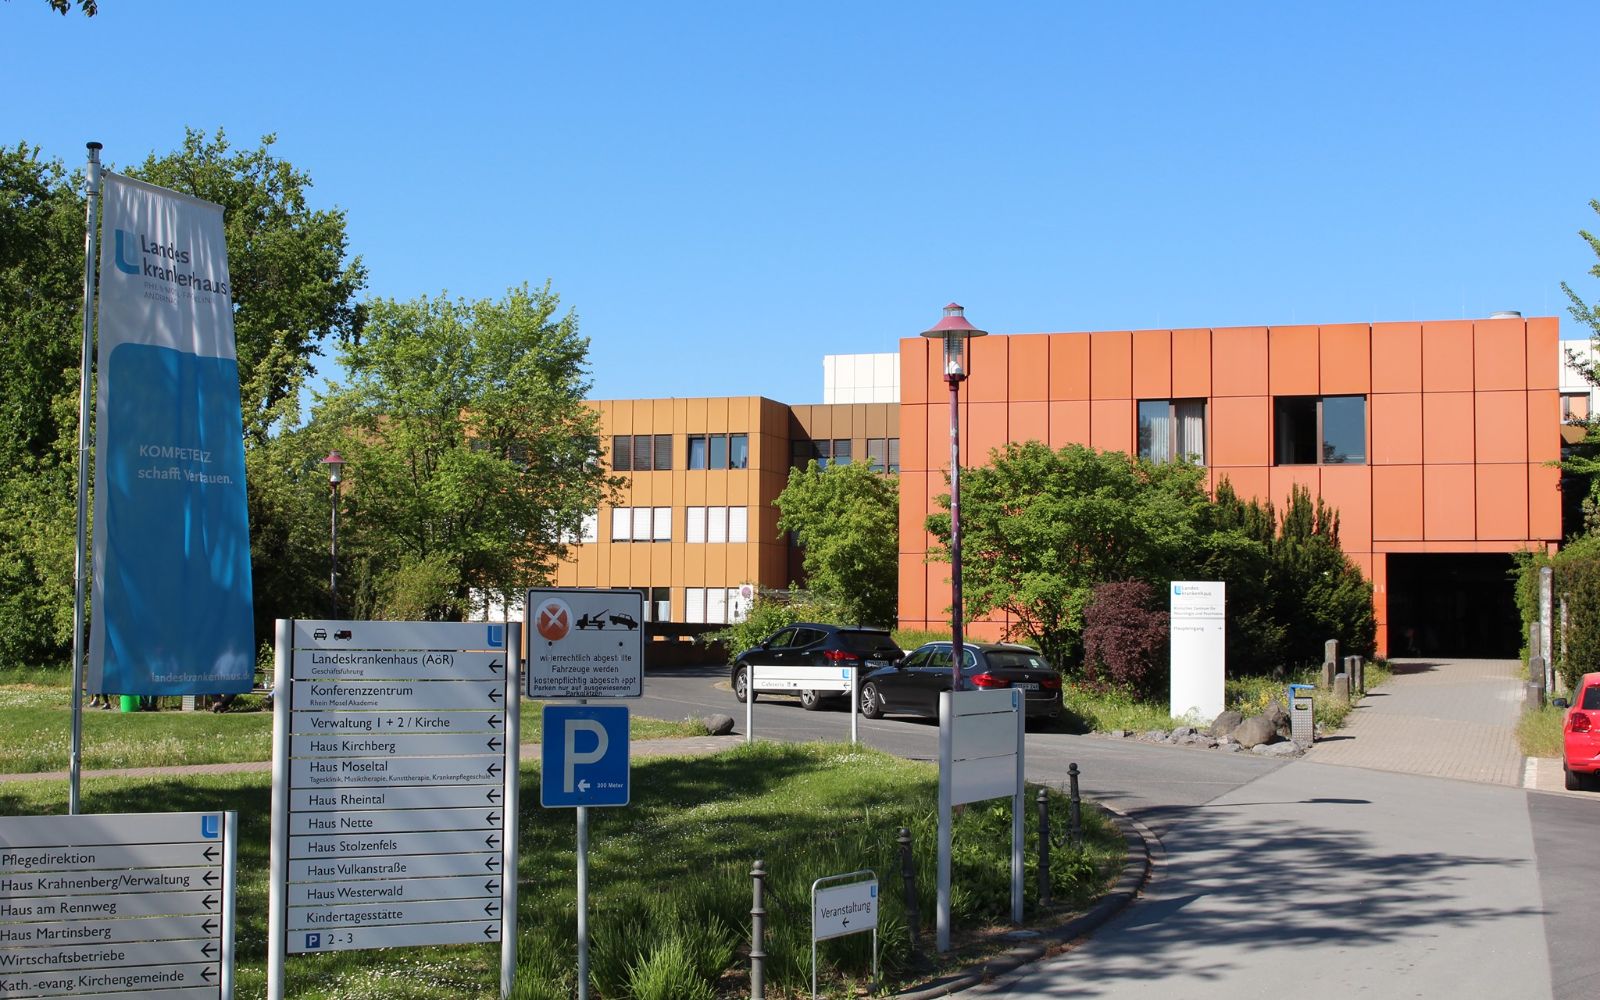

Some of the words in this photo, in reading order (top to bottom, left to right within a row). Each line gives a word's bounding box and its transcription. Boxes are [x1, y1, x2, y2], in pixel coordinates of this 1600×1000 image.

[138, 465, 181, 481] schafft
[312, 653, 418, 665] Landeskrankenhaus
[422, 654, 454, 668] (AöR)
[594, 654, 632, 663] abgestllte
[552, 665, 590, 674] Fahrzeuge
[534, 676, 587, 685] kostenpflichtig
[590, 677, 636, 686] abgeschppt
[310, 685, 413, 696] Konferenzzentrum
[311, 717, 372, 730] Verwaltung
[398, 717, 405, 728] 2
[407, 717, 412, 728] /
[416, 717, 450, 728] Kirche
[310, 741, 338, 752] Haus
[342, 741, 396, 753] Kirchberg
[564, 719, 609, 793] P
[310, 762, 338, 772] Haus
[342, 760, 388, 772] Moseltal
[309, 794, 337, 806] Haus
[341, 794, 386, 805] Rheintal
[308, 818, 336, 829] Haus
[340, 818, 373, 828] Nette
[308, 842, 336, 852] Haus
[340, 839, 398, 852] Stolzenfels
[2, 853, 96, 868] Pflegedirektion
[308, 865, 335, 876] Haus
[337, 862, 407, 875] Vulkanstraße
[1, 879, 33, 892] Haus
[38, 874, 190, 891] Krahnenberg/Verwaltung
[307, 888, 335, 900] Haus
[337, 886, 404, 898] Westerwald
[1, 904, 32, 916] Haus
[36, 906, 56, 916] am
[60, 902, 117, 915] Rennweg
[821, 902, 871, 918] Veranstaltung
[306, 909, 404, 924] Kindertagesstätte
[0, 929, 32, 941] Haus
[36, 926, 112, 940] Martinsberg
[328, 934, 336, 945] 2
[347, 933, 353, 944] 3
[0, 950, 125, 966] Wirtschaftsbetriebe
[78, 970, 185, 988] Kirchengemeinde
